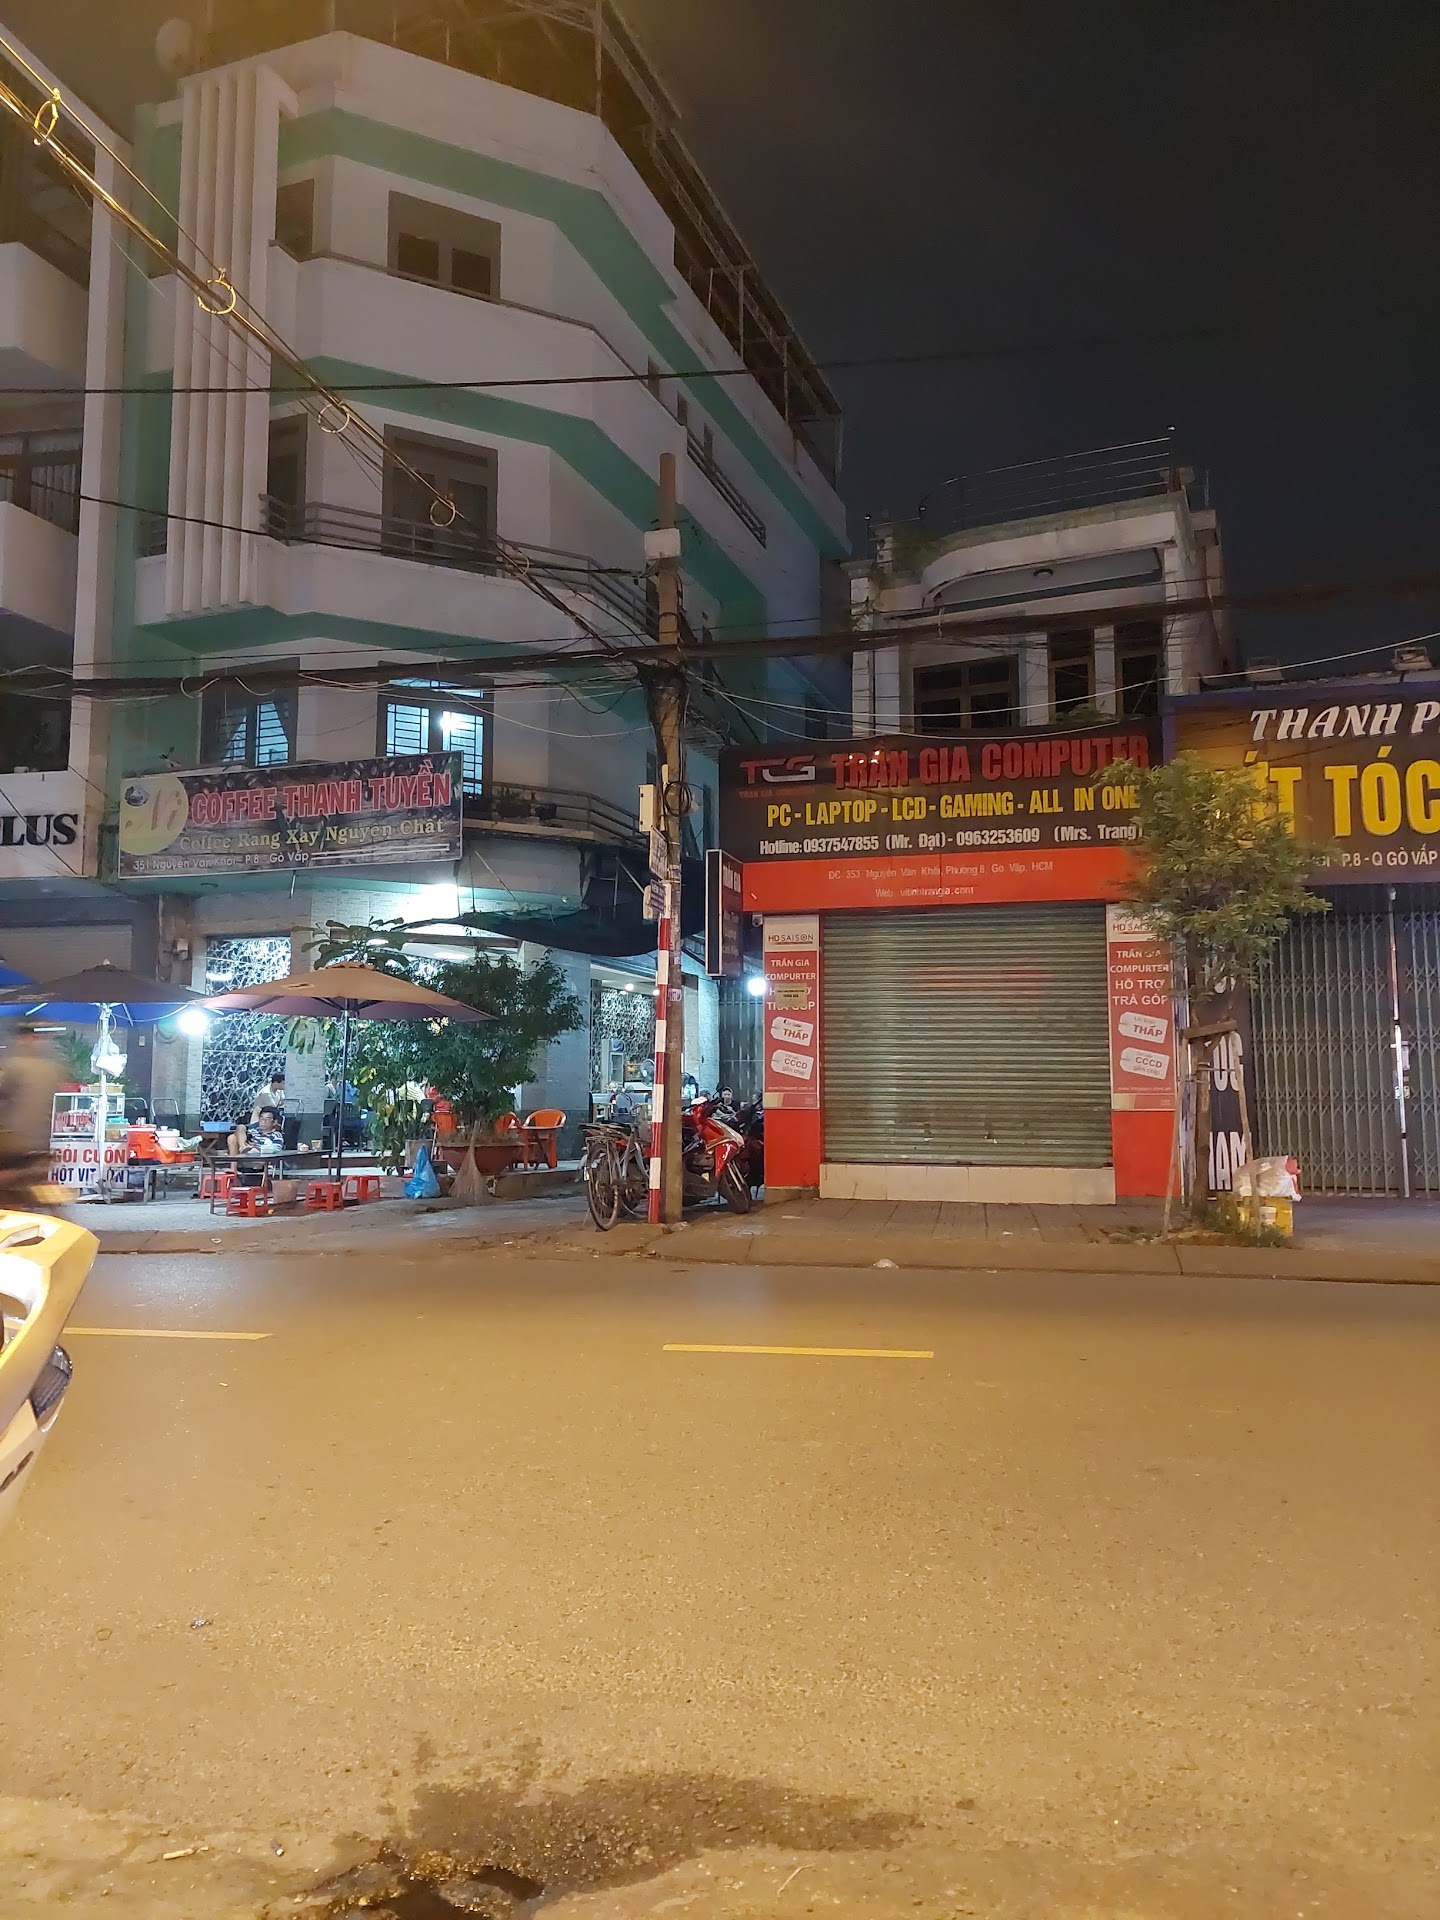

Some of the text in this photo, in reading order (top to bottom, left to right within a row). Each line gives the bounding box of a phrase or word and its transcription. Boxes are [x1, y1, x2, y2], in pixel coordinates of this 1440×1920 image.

[1250, 701, 1440, 741] THANH P
[919, 746, 971, 785] GIA
[981, 736, 1149, 782] COMPUTER
[192, 760, 451, 825] COFFEE THANH TUYỀN
[1324, 746, 1440, 837] TÓC
[767, 804, 791, 828] PC
[805, 800, 877, 826] LAPTOP
[892, 796, 927, 821] LCD
[940, 792, 1014, 818] GAMING
[1029, 789, 1064, 814] ALL
[1074, 787, 1094, 811] IN
[1101, 785, 1141, 810] ONE
[0, 814, 78, 846] LUS
[180, 834, 231, 851] Coffee
[237, 831, 281, 849] Rang
[285, 829, 319, 847] Xay
[325, 822, 392, 845] Nguyên
[886, 833, 912, 851] (Mr.
[919, 832, 946, 851] Đạt)
[956, 828, 1040, 846] 0963253609
[1054, 825, 1092, 841] (Mrs.
[269, 852, 285, 863] Gò
[1342, 851, 1361, 867] P.8
[1372, 852, 1383, 867] Q
[1387, 847, 1408, 867] GÒ
[1412, 843, 1438, 866] VẤP
[845, 869, 860, 879] 353
[1031, 861, 1054, 871] HCM
[795, 959, 809, 967] GIA
[1110, 964, 1169, 973] COMPURTER
[765, 972, 816, 981] COMPURTER
[1112, 993, 1138, 1005] TRẢ
[784, 1058, 808, 1070] CCCD
[1135, 1056, 1163, 1068] CCCD
